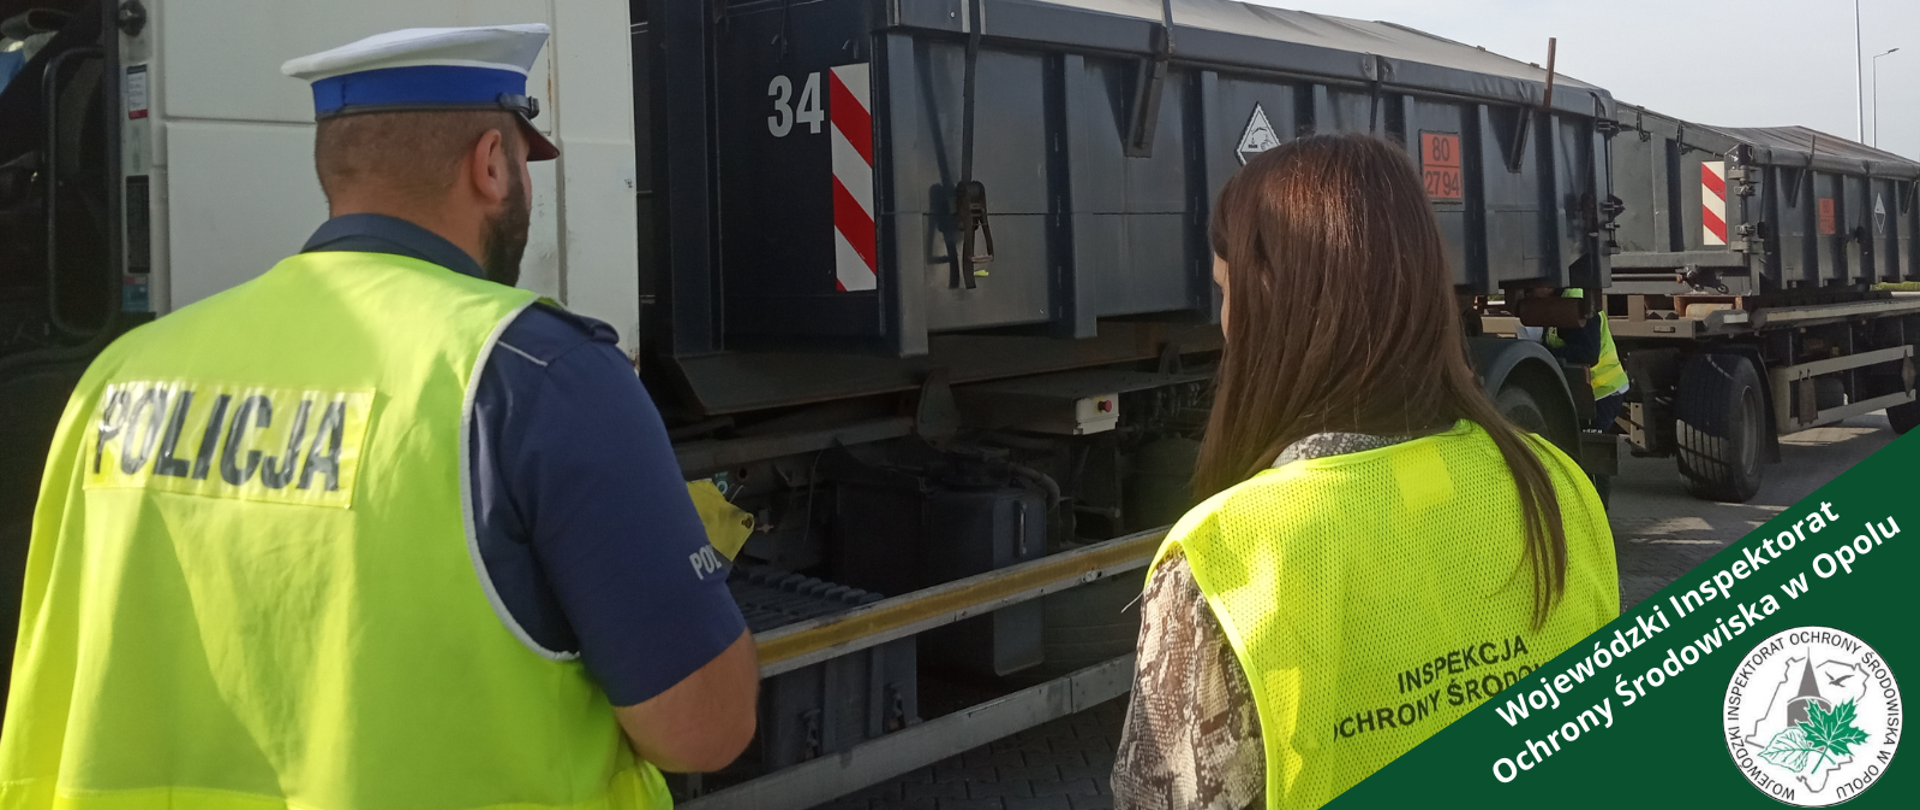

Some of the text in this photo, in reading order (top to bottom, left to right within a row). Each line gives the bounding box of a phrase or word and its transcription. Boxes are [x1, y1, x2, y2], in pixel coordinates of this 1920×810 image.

[767, 71, 825, 138] 34
[1432, 136, 1450, 162] 80
[1425, 170, 1460, 196] 2794
[93, 387, 346, 491] POLICJA
[1398, 635, 1529, 694] INSPEKCJA
[1447, 662, 1548, 706] ŚRODO
